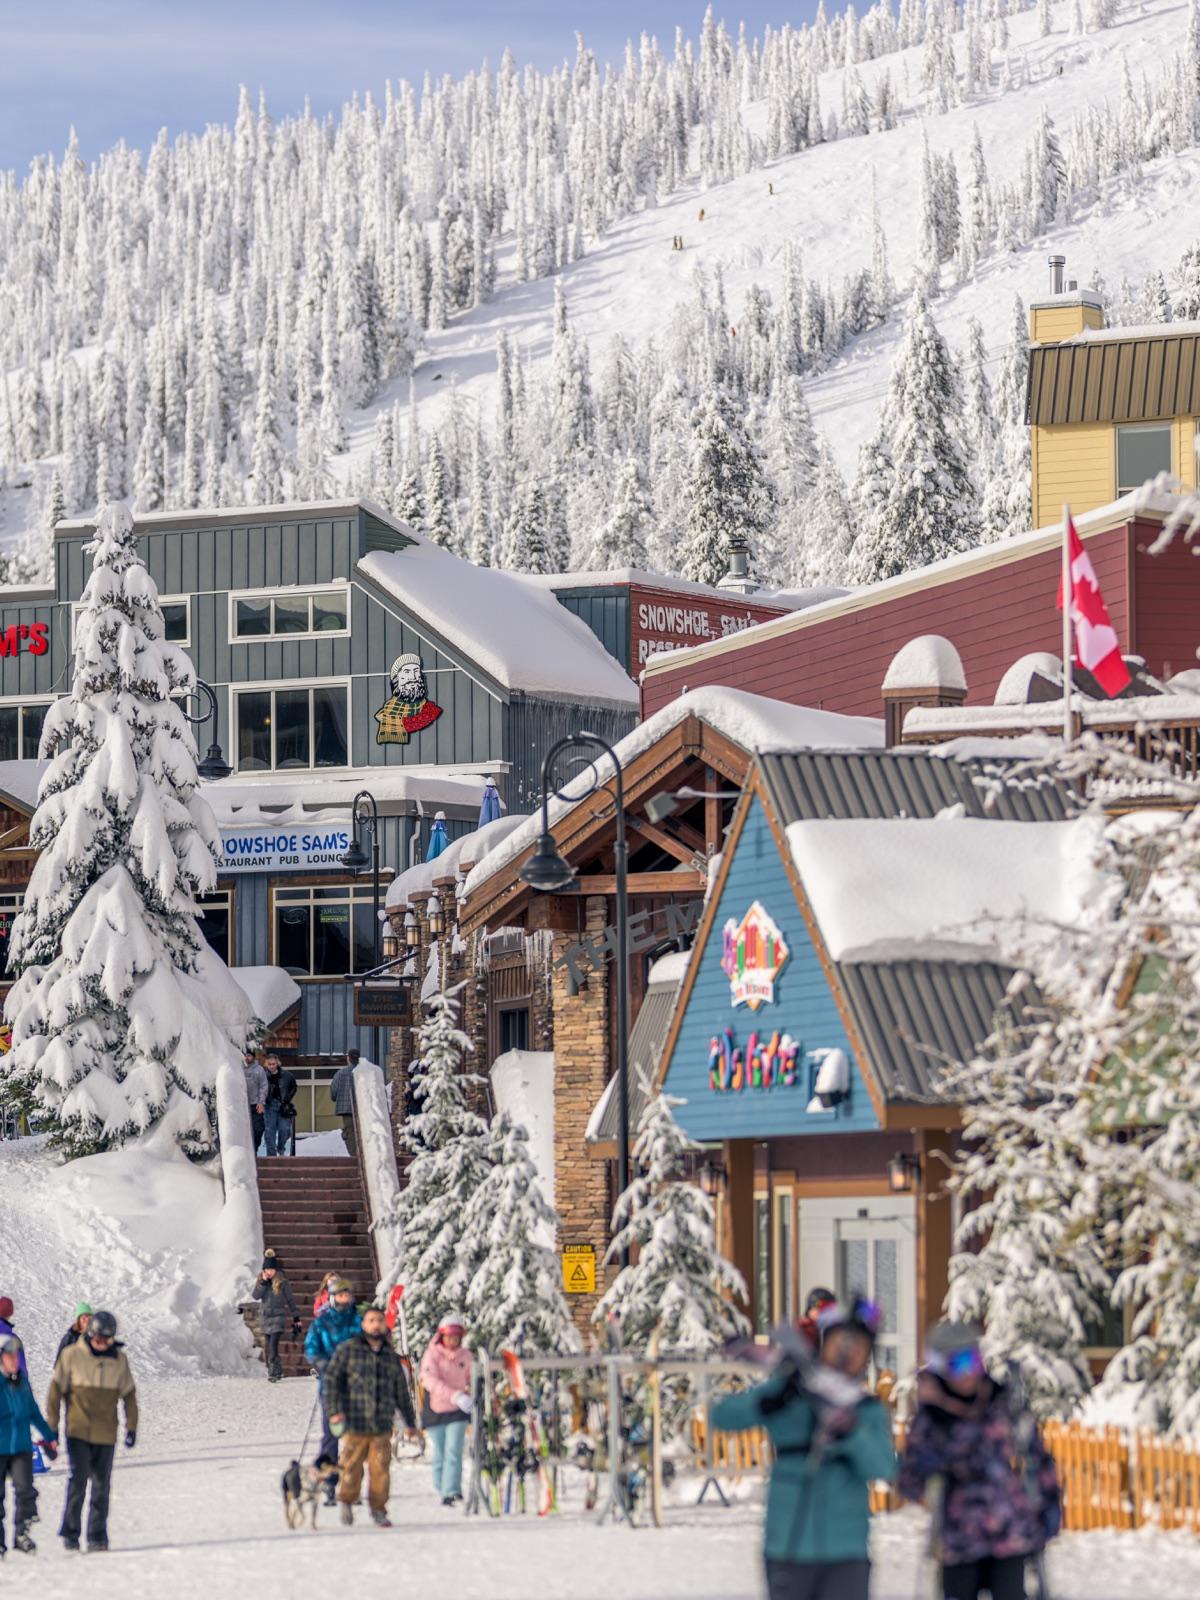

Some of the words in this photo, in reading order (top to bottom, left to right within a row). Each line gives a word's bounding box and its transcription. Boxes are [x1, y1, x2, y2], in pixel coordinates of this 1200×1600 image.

[638, 603, 709, 637] SNOWSHOE
[302, 832, 348, 851] SAM'S
[279, 855, 299, 865] PUB
[307, 853, 347, 864] LOUNG
[565, 1245, 592, 1254] CAUTION
